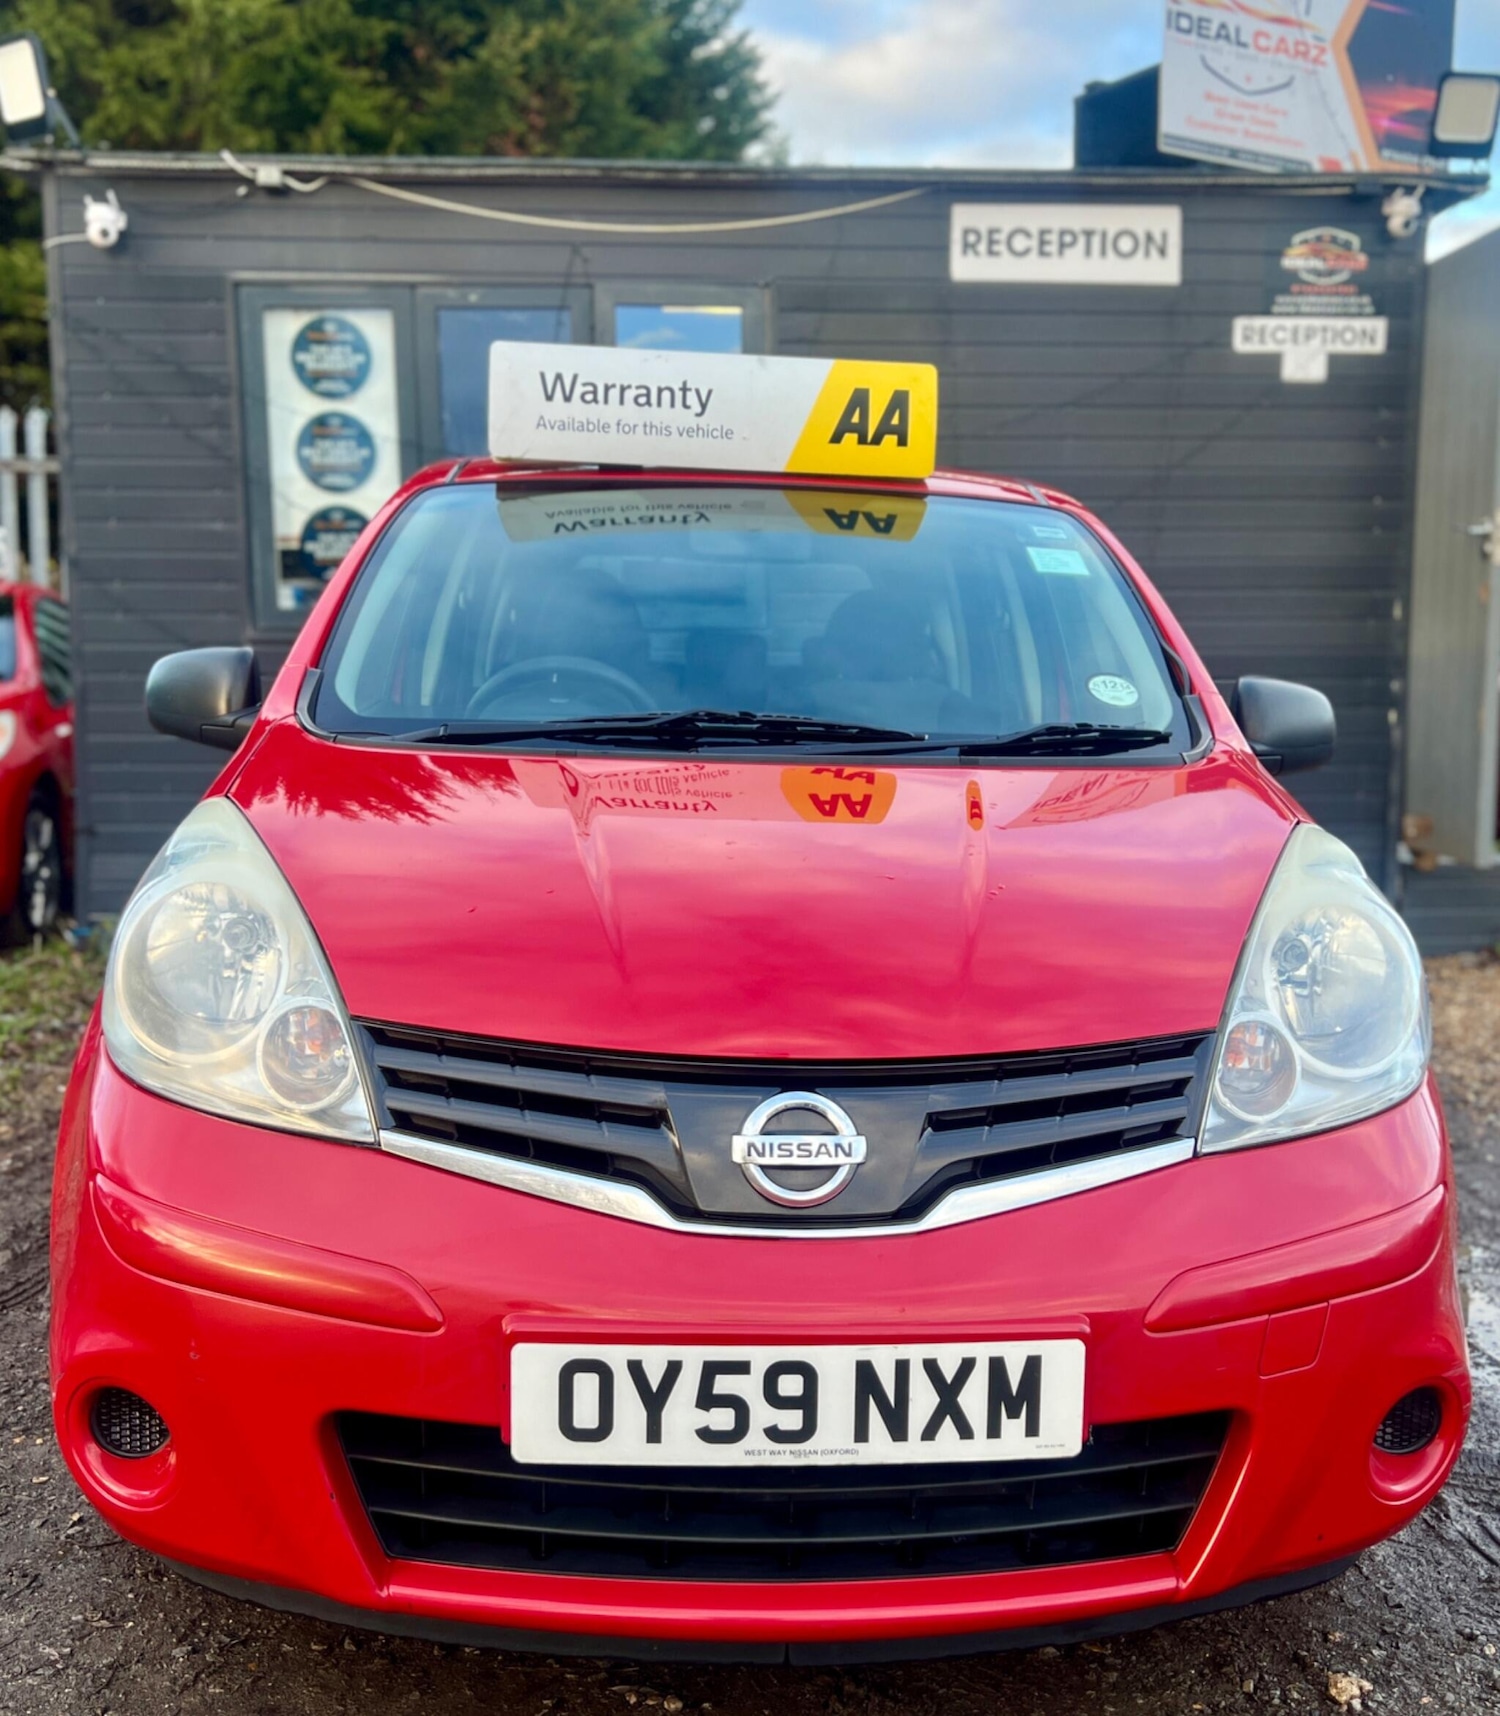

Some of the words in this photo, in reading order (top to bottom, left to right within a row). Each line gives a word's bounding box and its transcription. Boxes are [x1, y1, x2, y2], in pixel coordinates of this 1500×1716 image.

[960, 227, 1170, 260] RECEPTION
[1240, 322, 1379, 347] RECEPTION
[539, 370, 714, 417] Warranty
[535, 414, 612, 436] Available
[615, 417, 640, 437] for
[642, 418, 673, 438] this
[676, 422, 735, 441] vehicle
[828, 387, 910, 447] AA
[746, 1141, 853, 1159] NISSAN
[557, 1357, 820, 1445] OY59
[853, 1354, 1044, 1442] NXM
[744, 1449, 767, 1457] WEST
[789, 1448, 819, 1457] NISSAN
[820, 1448, 860, 1457] (OXFORD)
